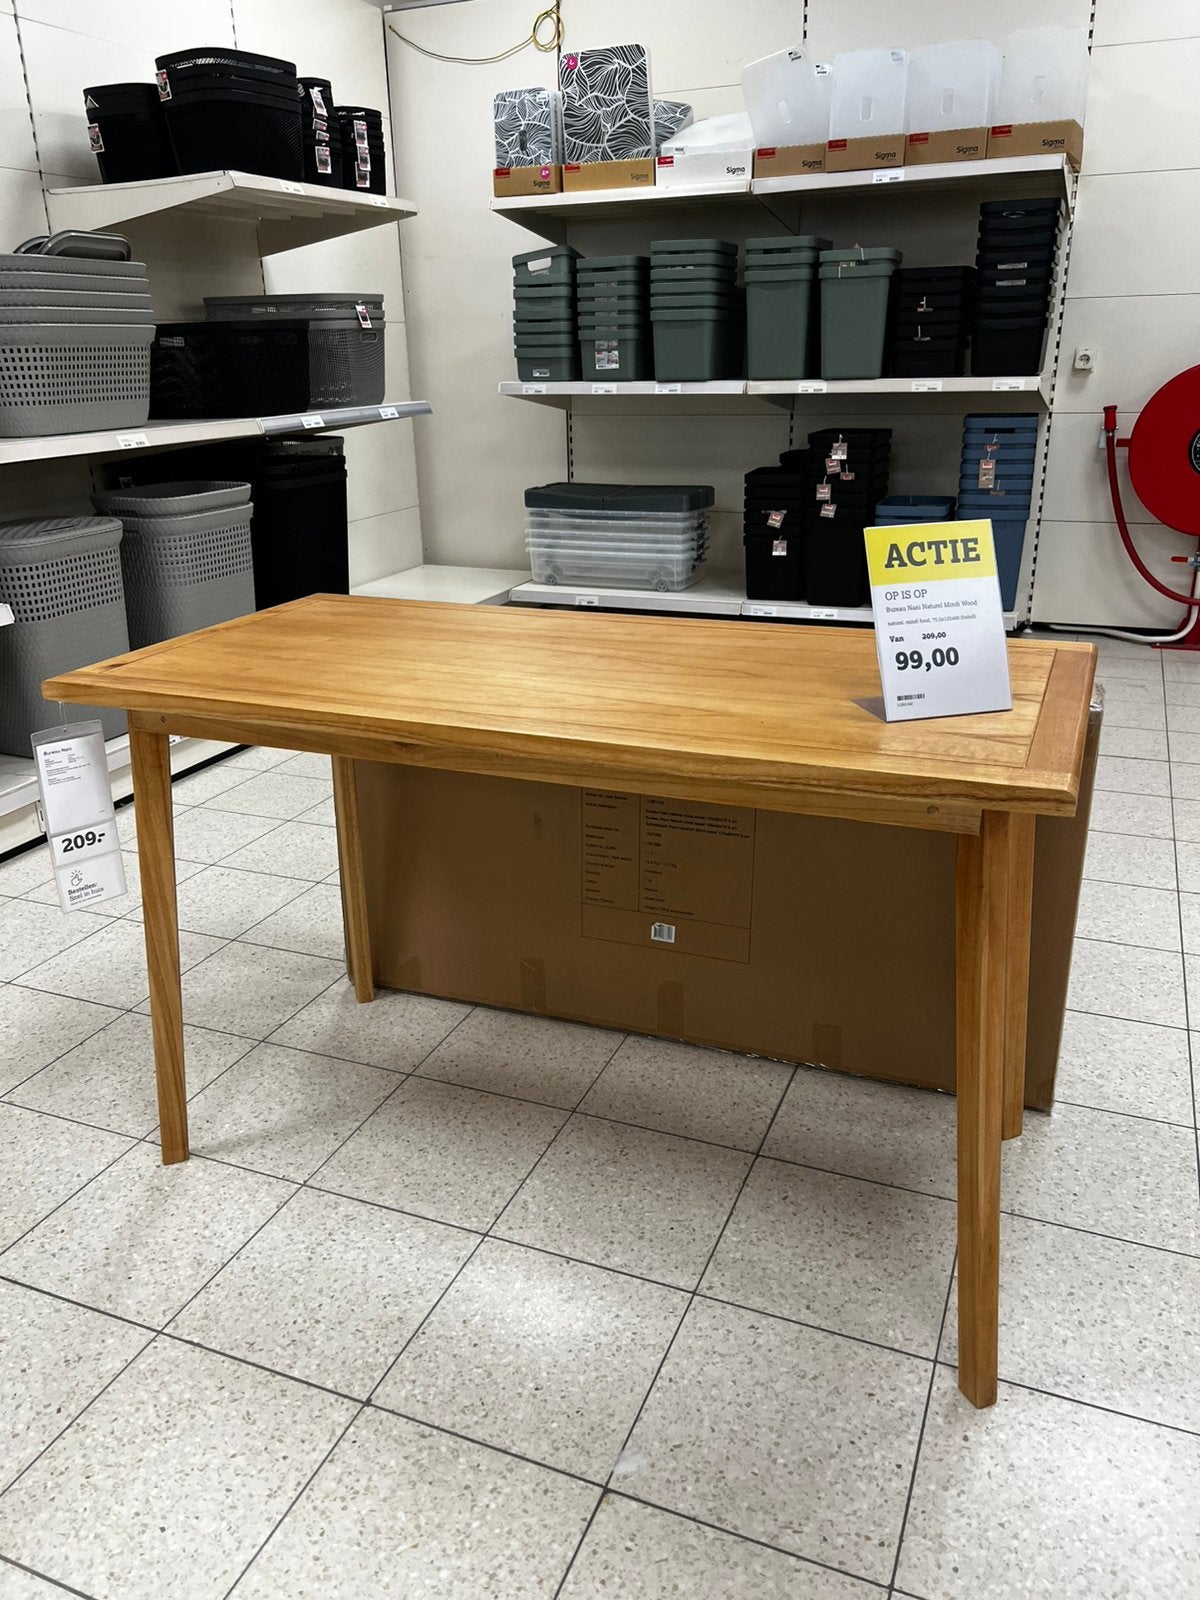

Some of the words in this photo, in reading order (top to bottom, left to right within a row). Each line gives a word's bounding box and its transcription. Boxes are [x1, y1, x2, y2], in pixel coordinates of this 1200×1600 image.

[1041, 138, 1065, 147] Sigma
[956, 145, 979, 154] Sigma
[875, 152, 897, 160] Sigma
[801, 160, 823, 168] Sigma
[726, 166, 746, 175] Sigma
[630, 173, 649, 181] Sigma
[533, 180, 551, 188] Sigma
[885, 538, 981, 569] ACTIE
[884, 591, 899, 601] OP
[901, 590, 912, 600] IS
[913, 589, 928, 599] OP
[889, 635, 905, 643] Van
[921, 631, 947, 641] 209,00
[895, 647, 959, 672] 99,00
[61, 831, 106, 853] 209.-
